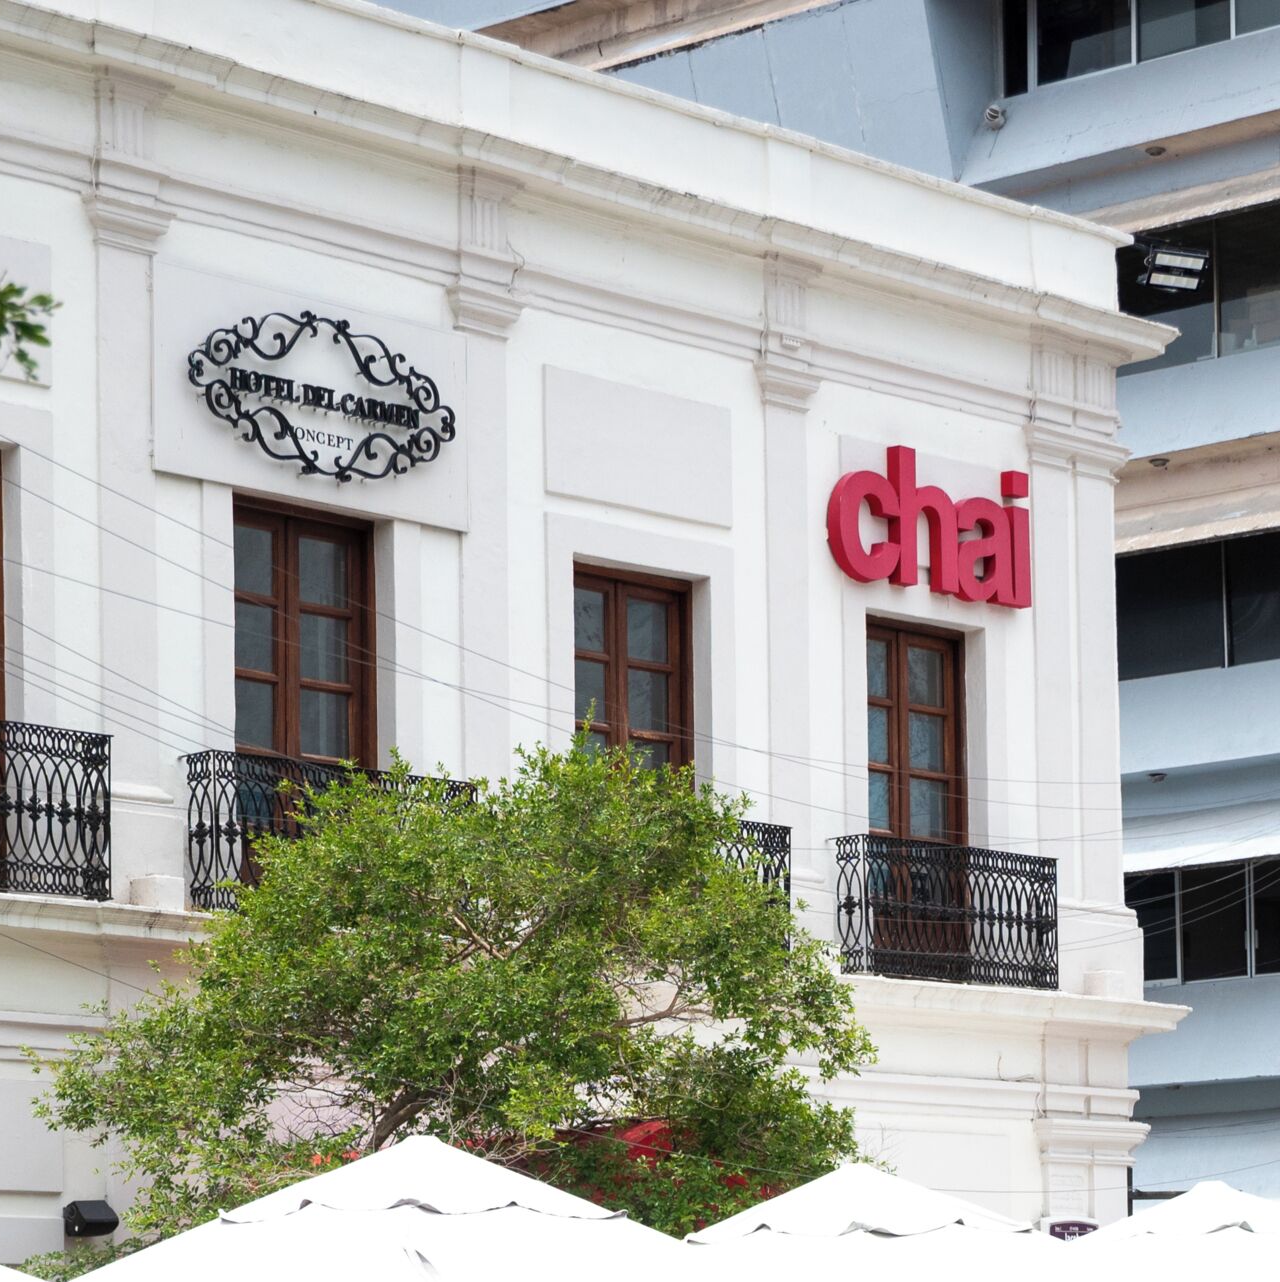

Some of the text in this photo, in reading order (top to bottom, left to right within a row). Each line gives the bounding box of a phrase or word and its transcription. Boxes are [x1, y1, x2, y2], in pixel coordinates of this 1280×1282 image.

[229, 367, 420, 429] HOTEL DEL CARMEN
[827, 445, 1031, 609] chai
